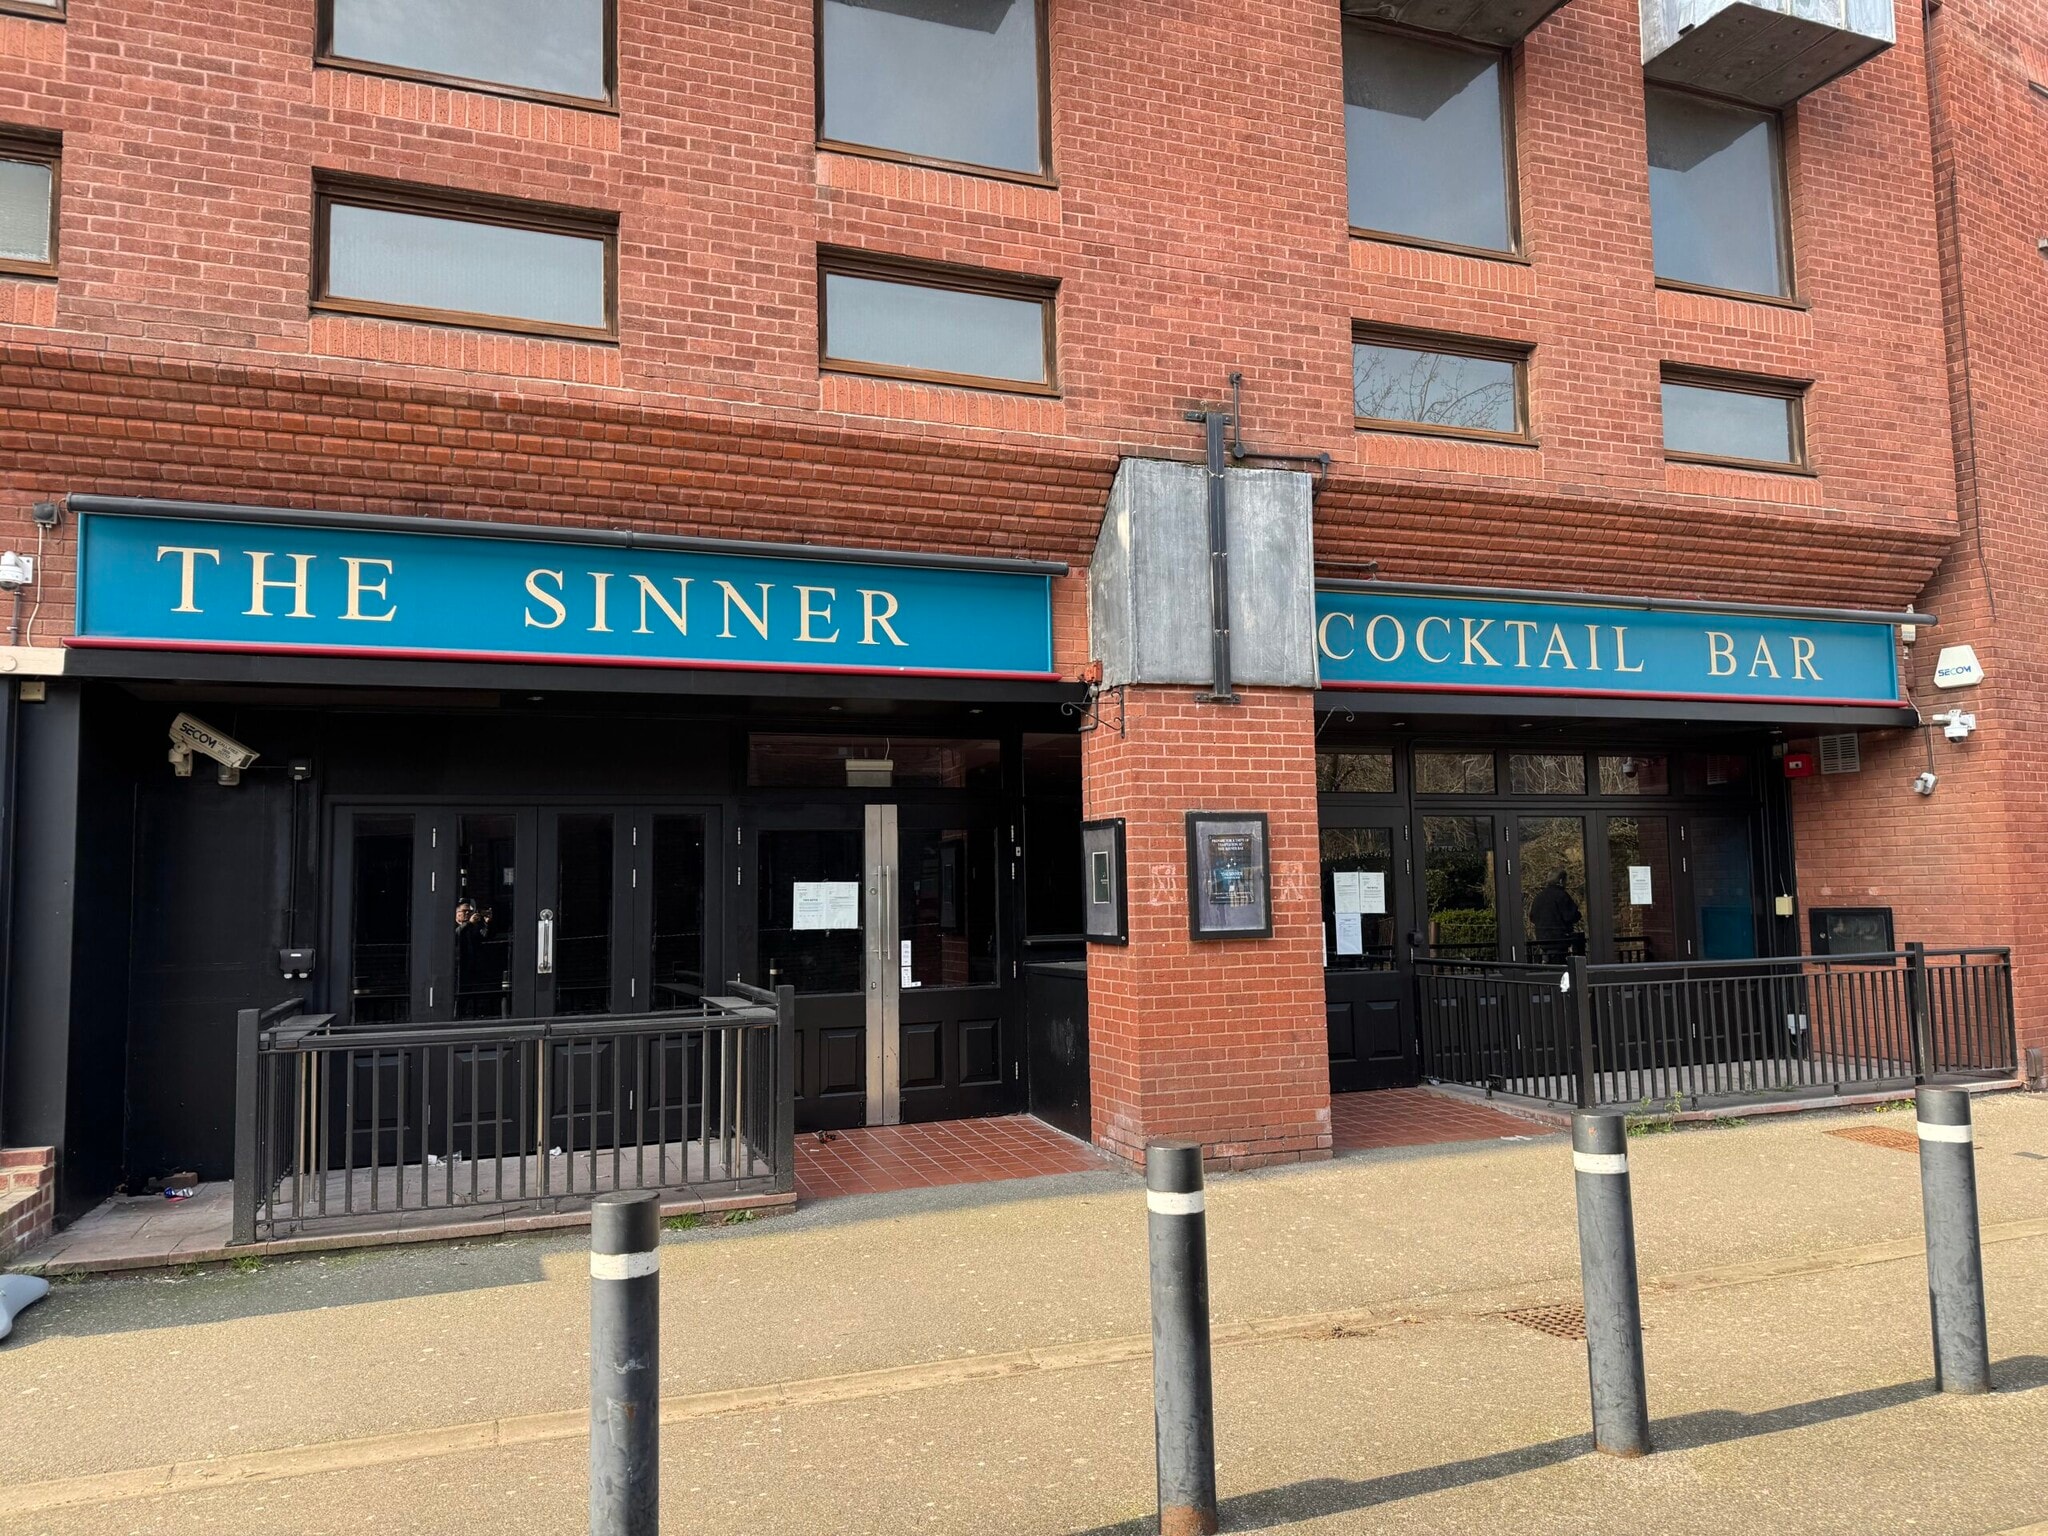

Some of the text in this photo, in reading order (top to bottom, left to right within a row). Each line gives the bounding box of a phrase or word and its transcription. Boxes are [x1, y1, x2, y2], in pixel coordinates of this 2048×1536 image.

[158, 547, 909, 646] THE SINNER
[1318, 612, 1823, 681] COCKTAIL BAR
[1938, 665, 1972, 677] SECOM
[179, 722, 218, 749] SECOM
